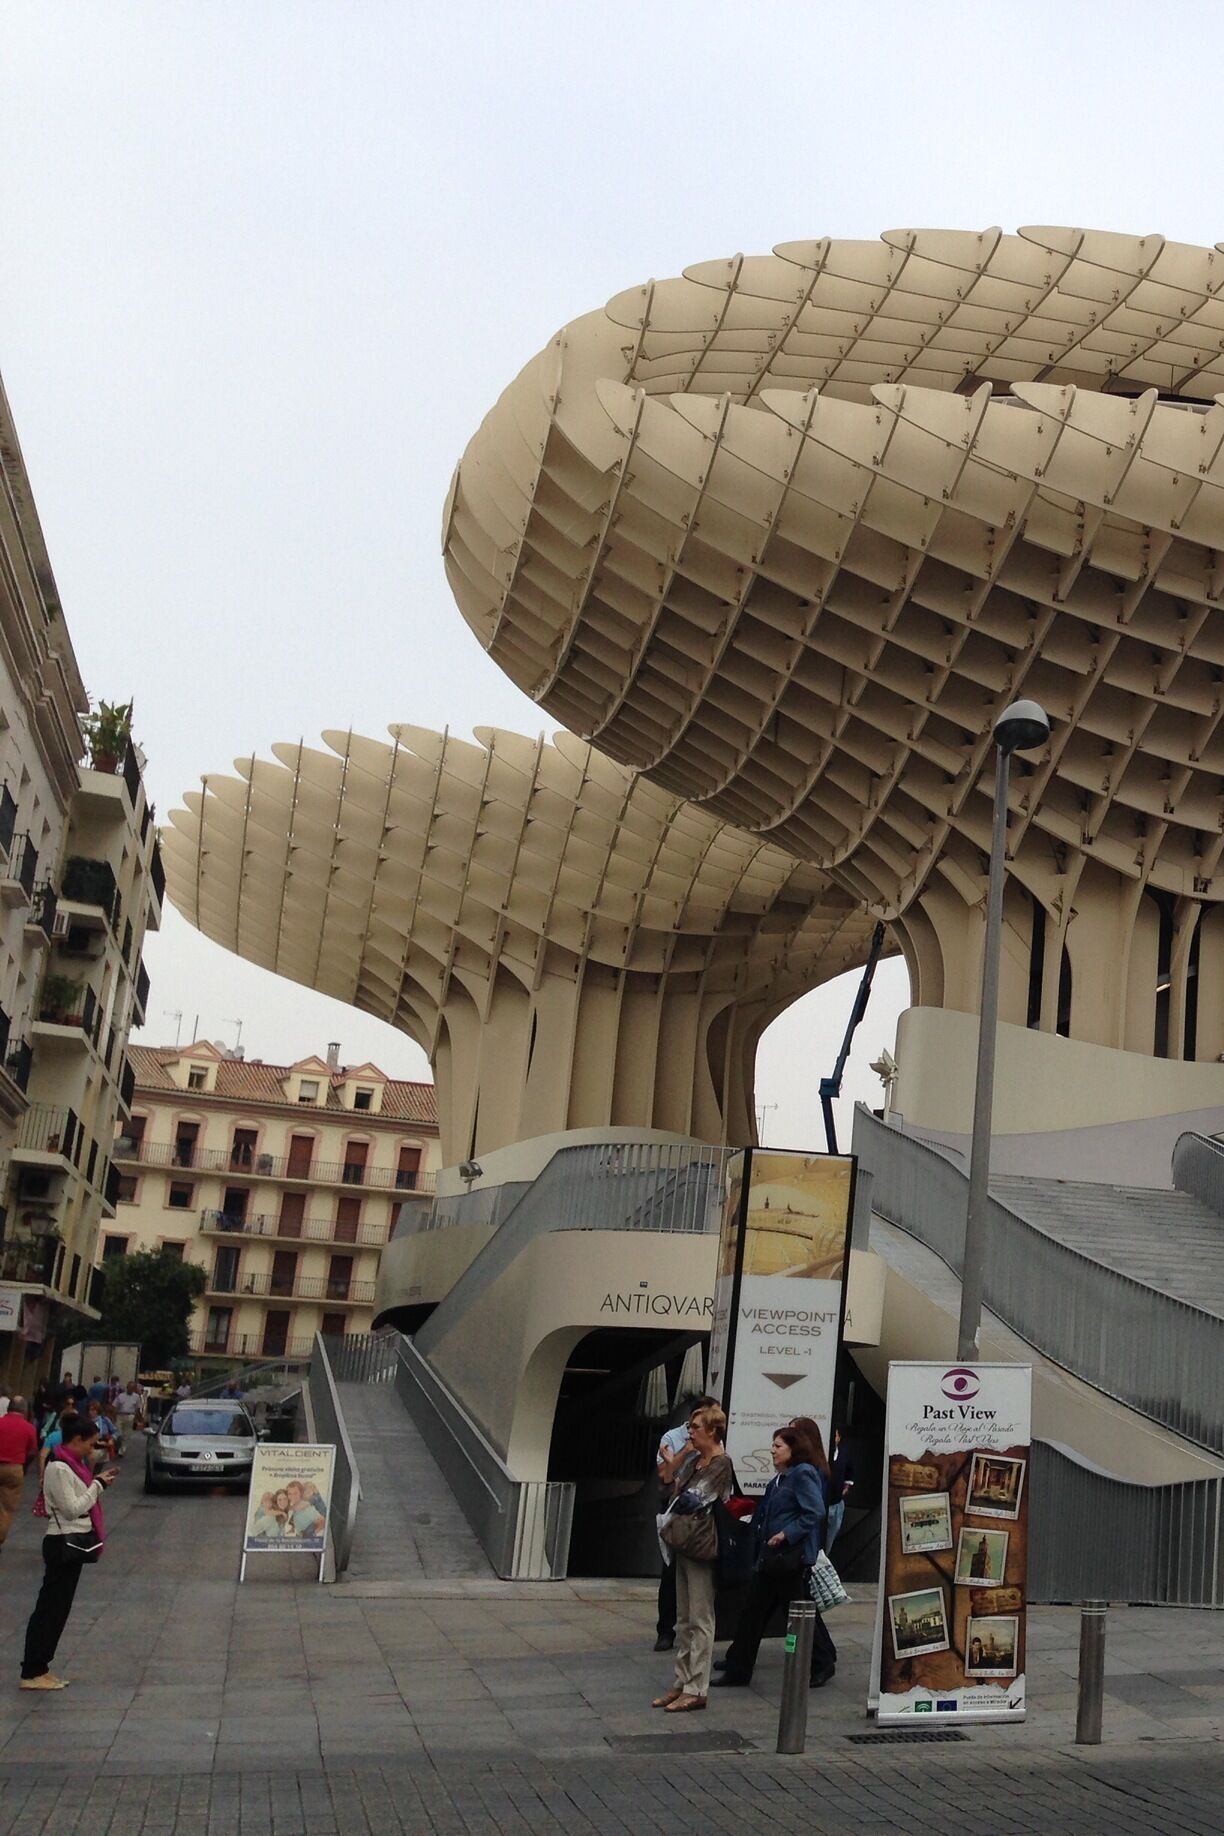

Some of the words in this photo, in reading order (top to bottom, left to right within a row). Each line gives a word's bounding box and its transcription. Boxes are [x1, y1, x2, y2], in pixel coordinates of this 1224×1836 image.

[600, 1293, 714, 1317] ANTIQVAR
[741, 1308, 837, 1323] VIEWPOINT
[751, 1323, 822, 1337] ACCESS
[760, 1346, 801, 1356] LEVEL
[923, 1405, 955, 1420] Past
[957, 1405, 997, 1420] View
[259, 1449, 330, 1458] VITALDENT
